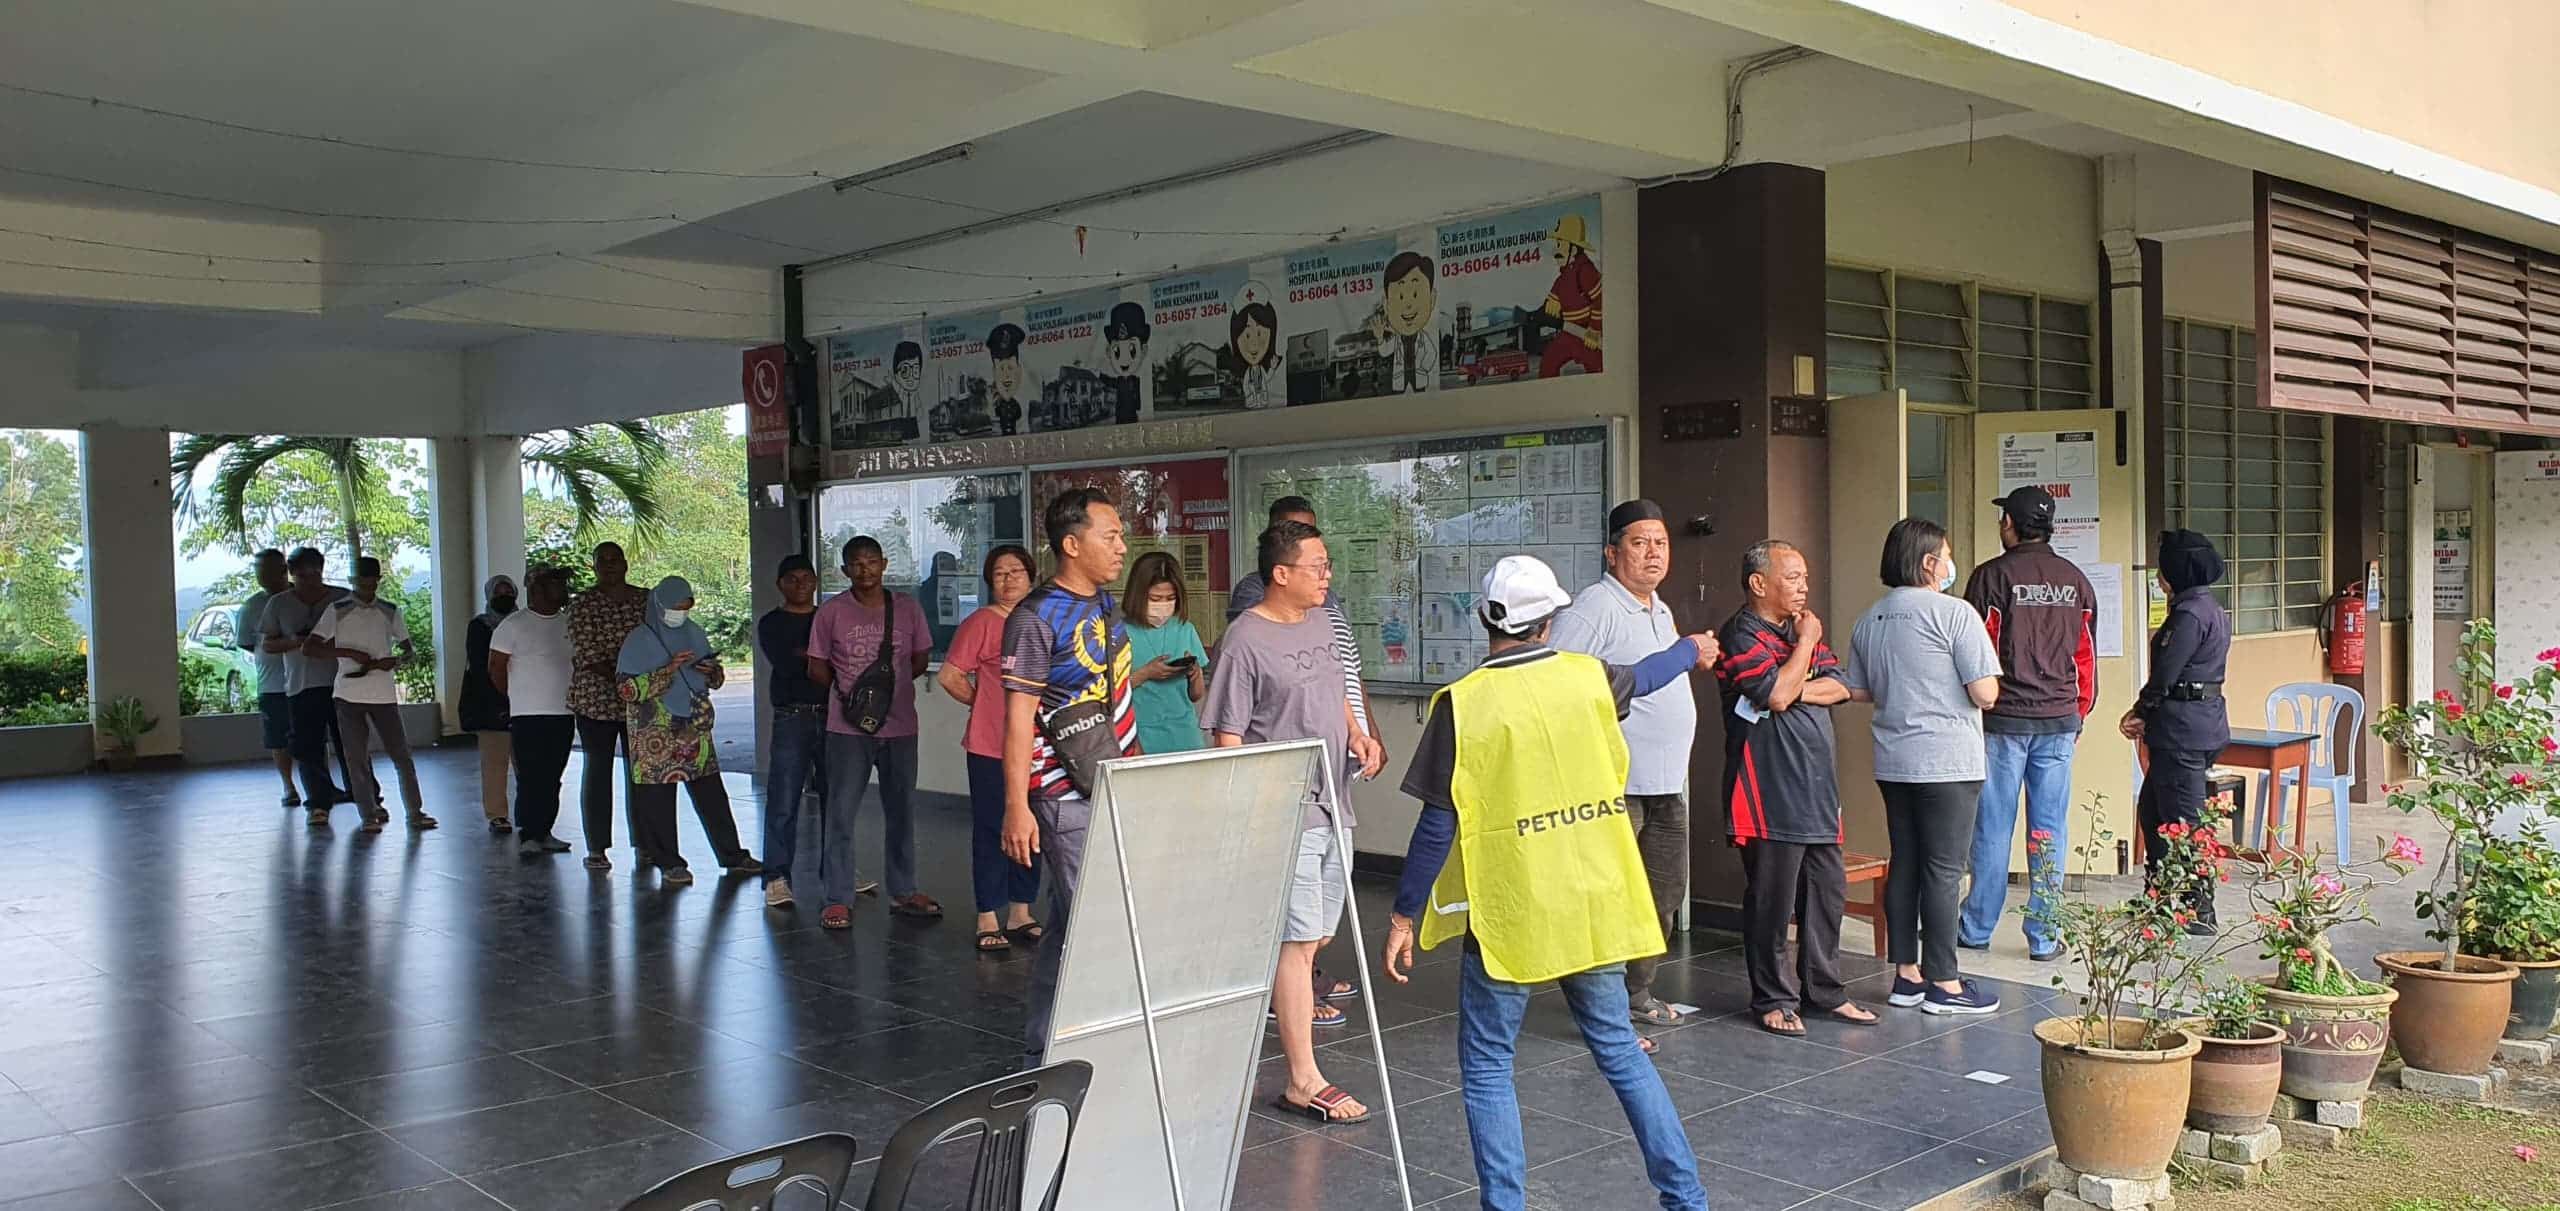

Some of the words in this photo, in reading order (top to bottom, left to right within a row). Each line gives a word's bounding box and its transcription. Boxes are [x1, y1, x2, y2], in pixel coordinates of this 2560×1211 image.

[1440, 245, 1469, 260] BOMBA
[1469, 240, 1495, 255] KUALA
[1496, 235, 1519, 249] KUBU
[1519, 229, 1547, 244] BHARU
[1288, 272, 1318, 288] HOSPITAL
[1319, 267, 1341, 281] KUALA
[1341, 263, 1361, 277] KUBU
[1361, 260, 1385, 274] BHARU
[1441, 253, 1500, 278] 03-6064
[1503, 247, 1541, 267] 1444
[1289, 283, 1338, 304] 03-6064
[1342, 278, 1374, 294] 1333
[1155, 307, 1197, 324] 03-6057
[1200, 302, 1227, 318] 3264
[1027, 329, 1065, 345] 03-6064
[1068, 325, 1092, 338] 1222
[1055, 713, 1106, 741] umbro
[1516, 796, 1626, 837] PETUGAS
